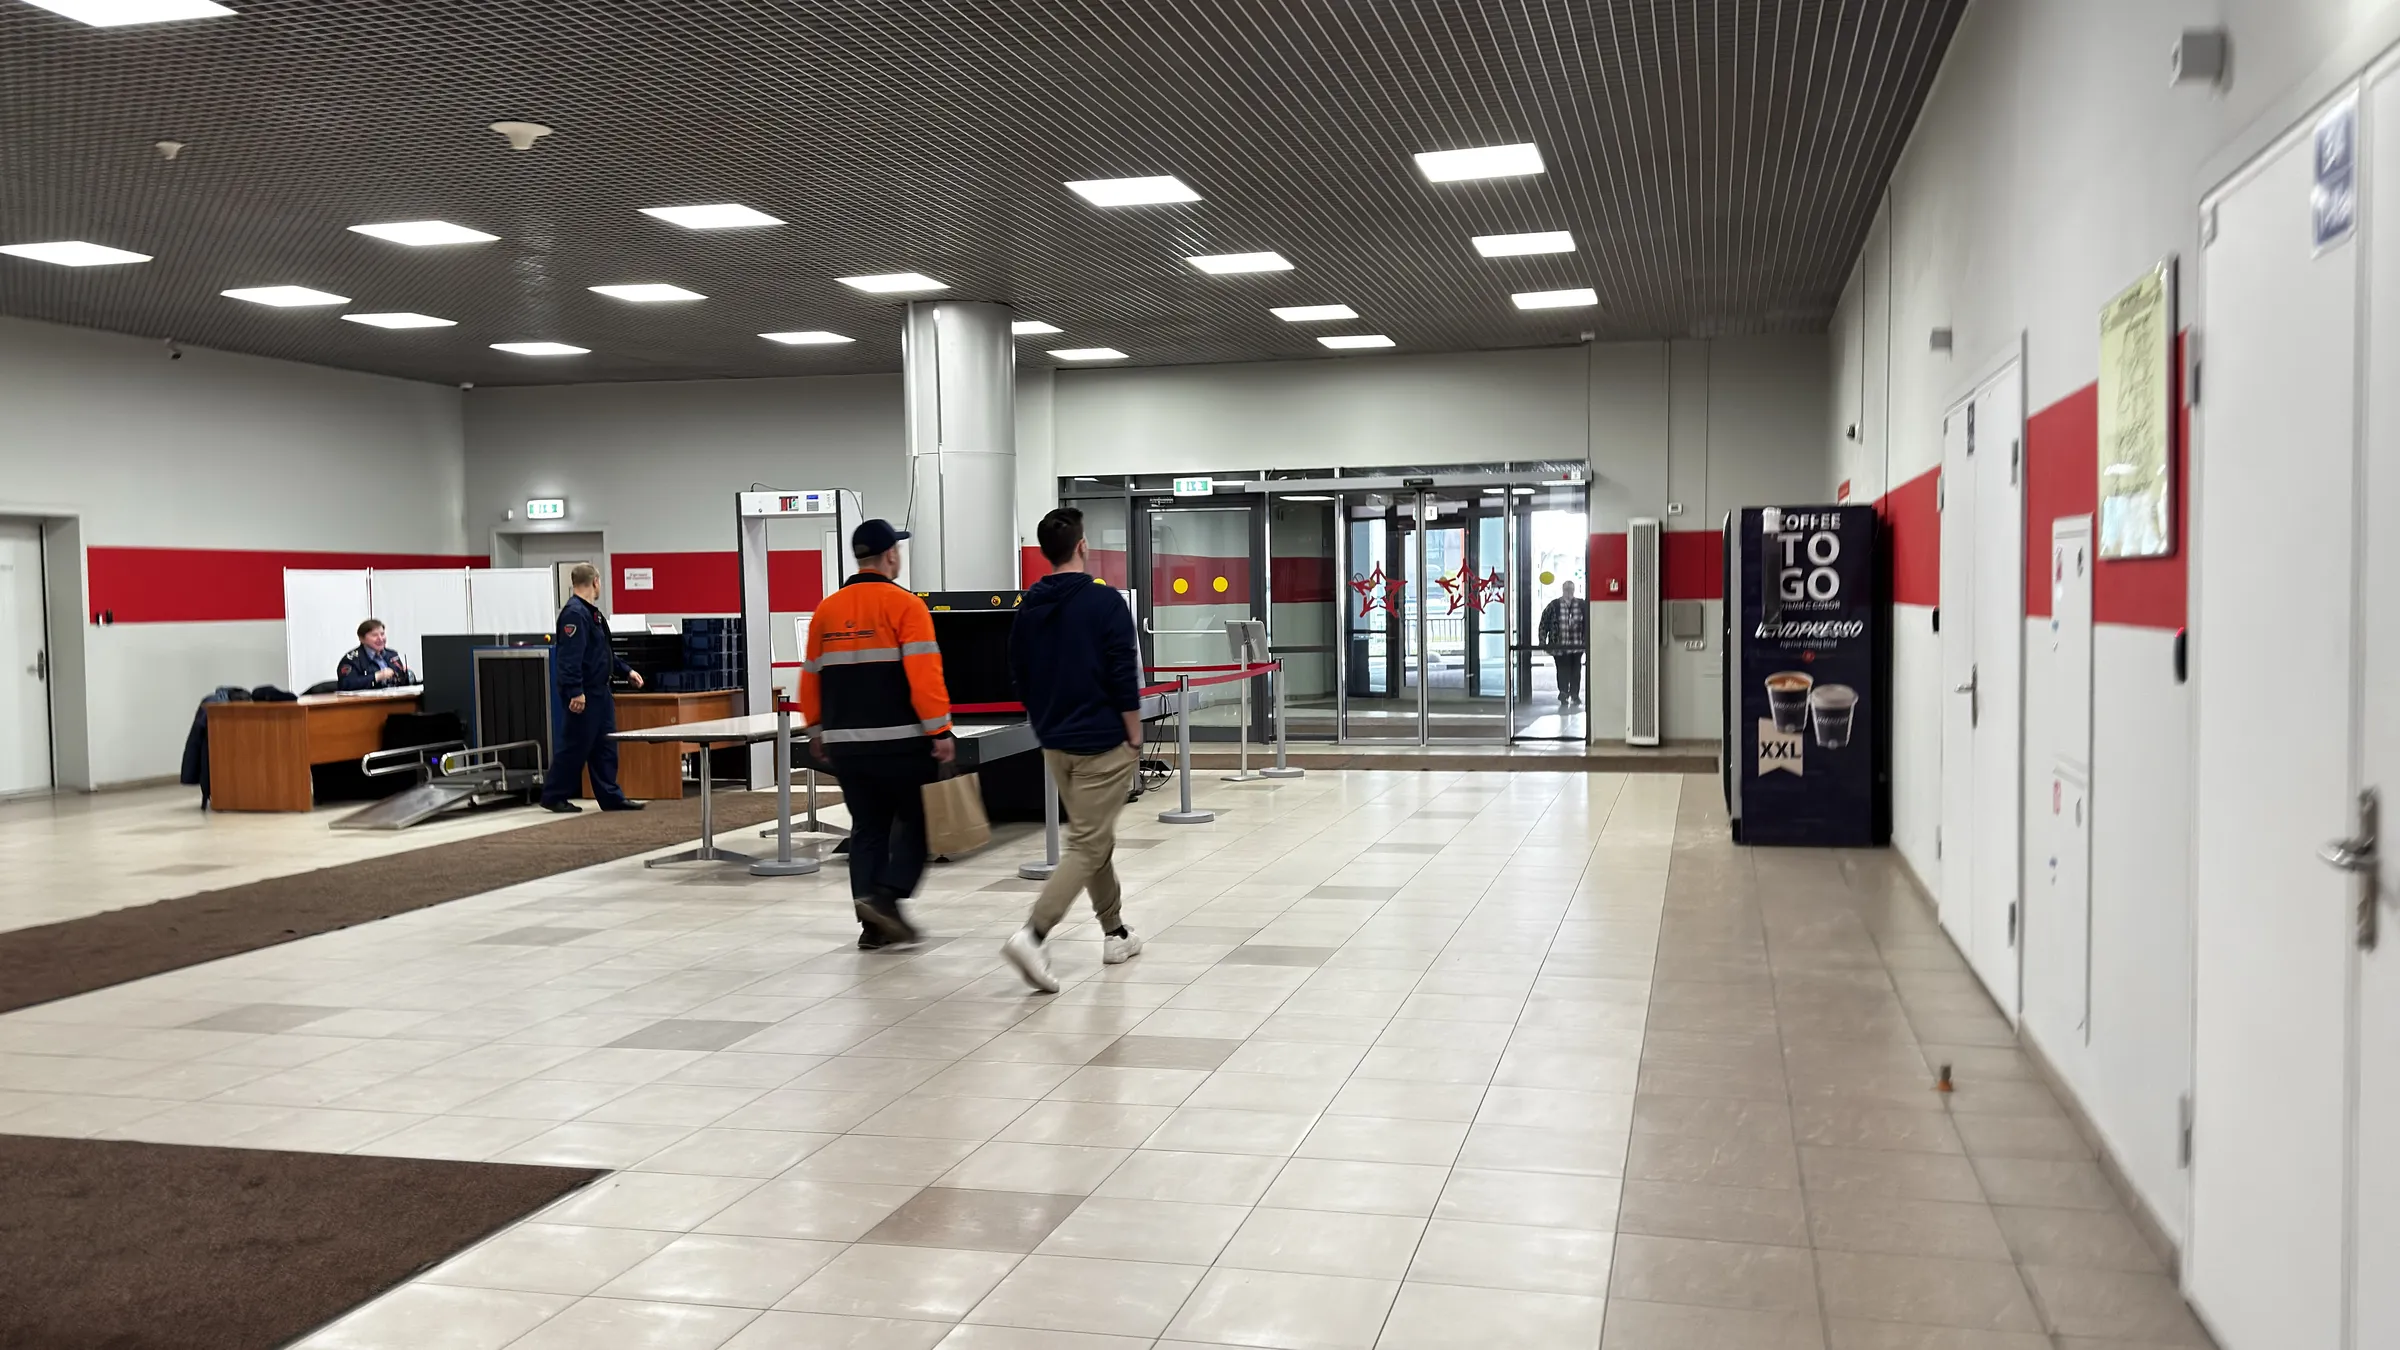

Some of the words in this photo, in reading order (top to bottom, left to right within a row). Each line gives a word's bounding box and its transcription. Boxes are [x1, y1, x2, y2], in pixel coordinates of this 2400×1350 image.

[1777, 530, 1840, 567] TO
[1780, 566, 1840, 601] GO
[1760, 740, 1802, 760] XXL
